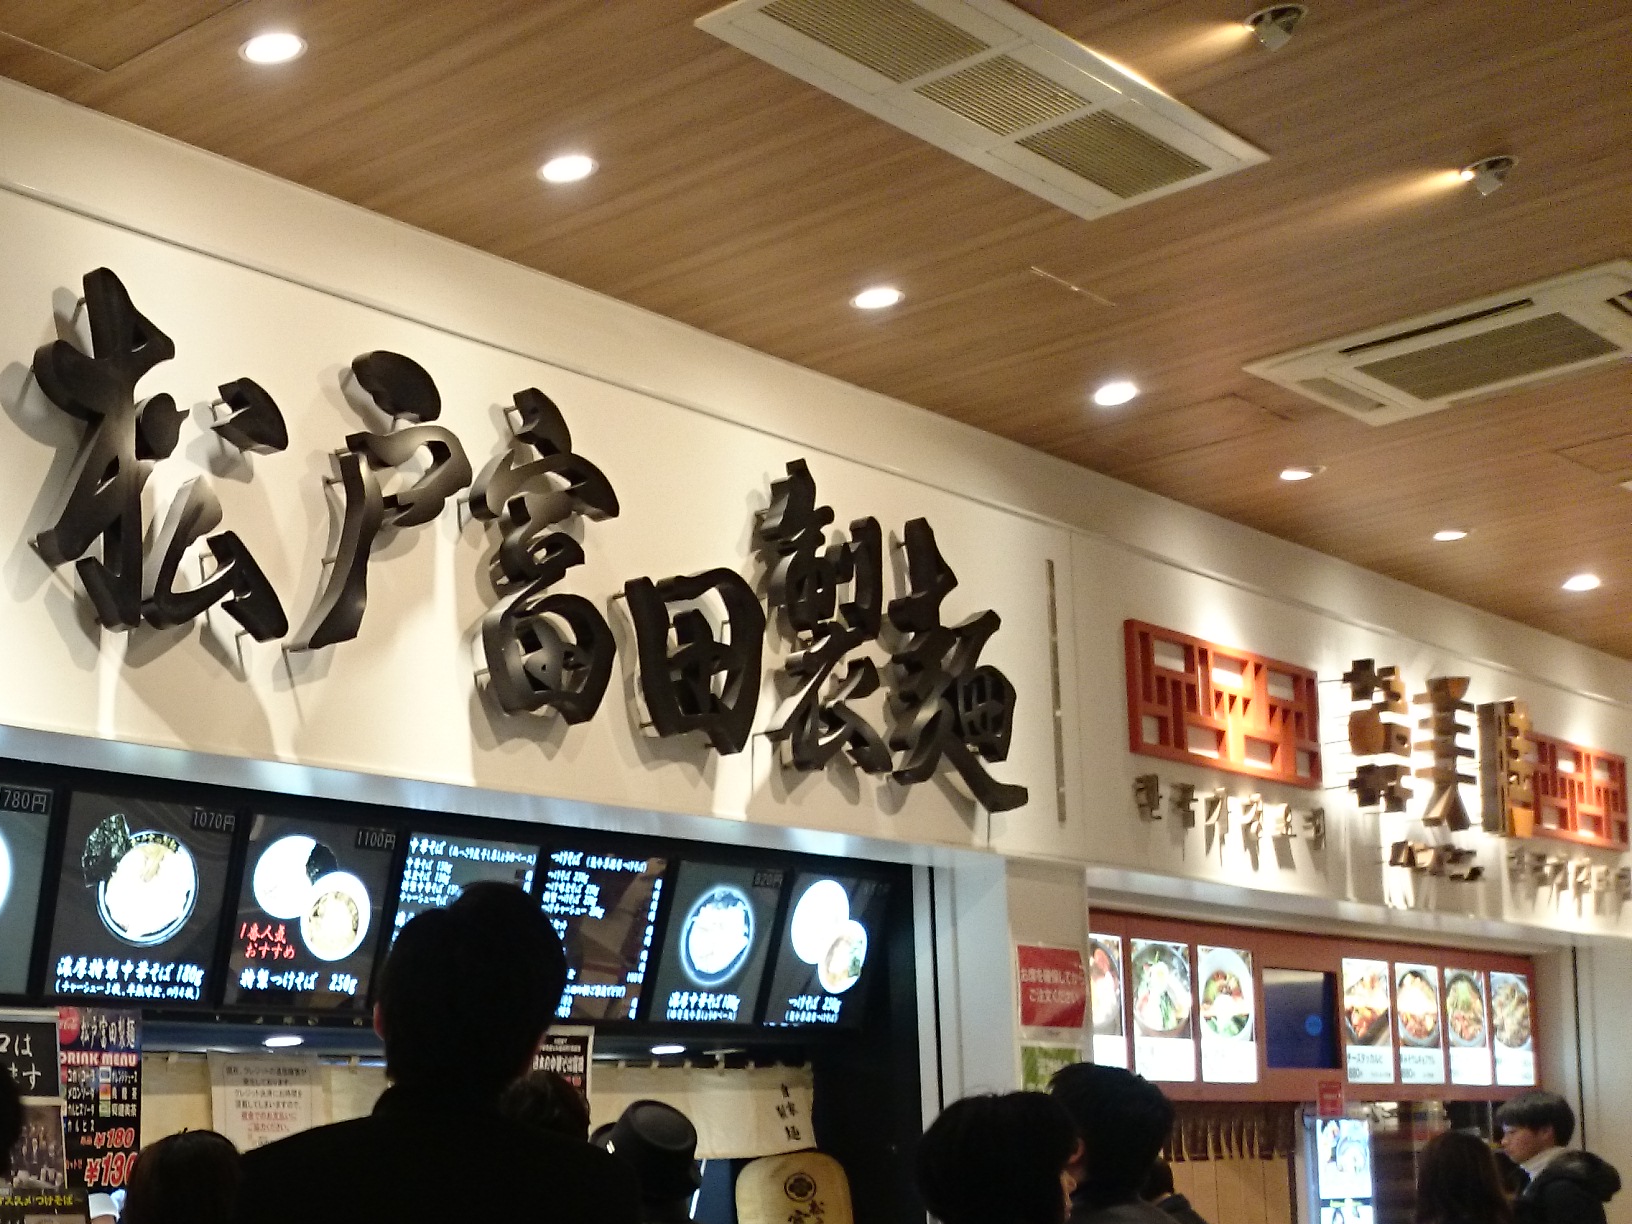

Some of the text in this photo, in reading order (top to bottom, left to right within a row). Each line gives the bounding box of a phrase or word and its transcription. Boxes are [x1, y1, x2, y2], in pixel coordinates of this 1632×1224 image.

[34, 267, 1028, 811] 松戸富田製麺
[2, 789, 46, 812] 780円
